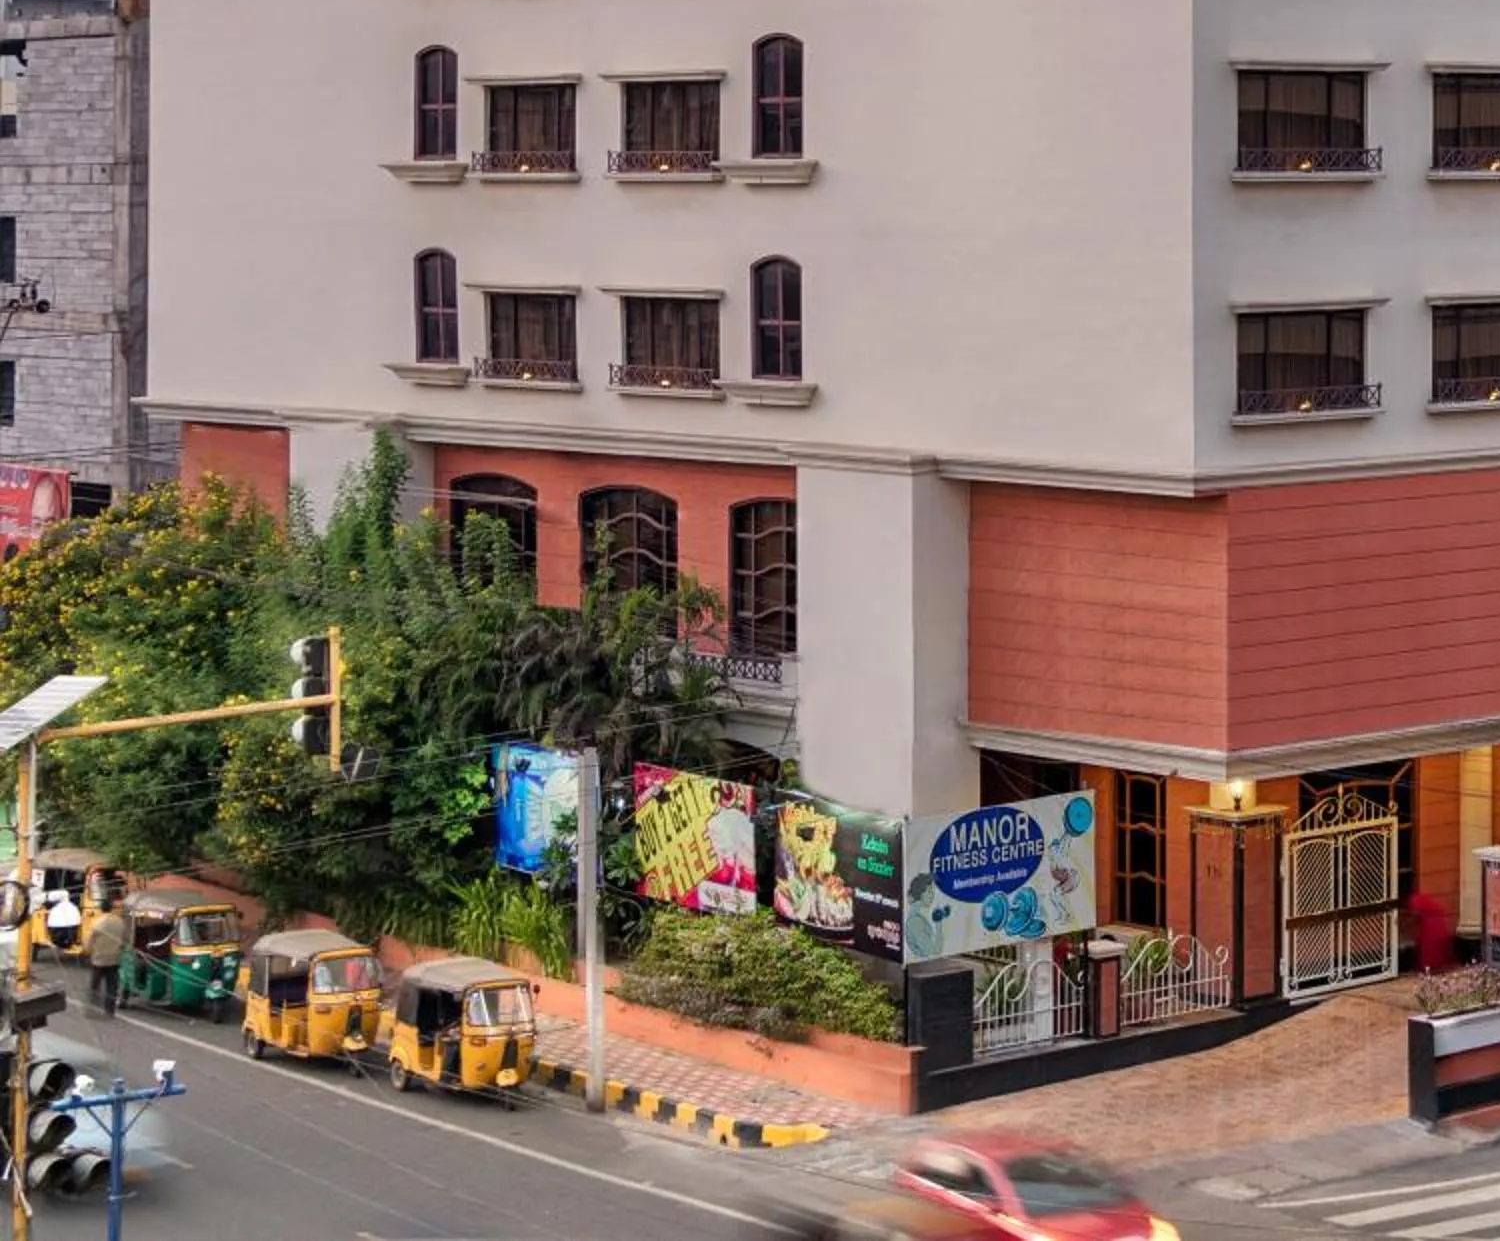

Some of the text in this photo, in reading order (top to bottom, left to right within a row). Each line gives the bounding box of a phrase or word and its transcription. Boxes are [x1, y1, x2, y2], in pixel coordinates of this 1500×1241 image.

[949, 812, 1030, 853] MANOR
[932, 838, 1045, 875] FITNESS CENTRE
